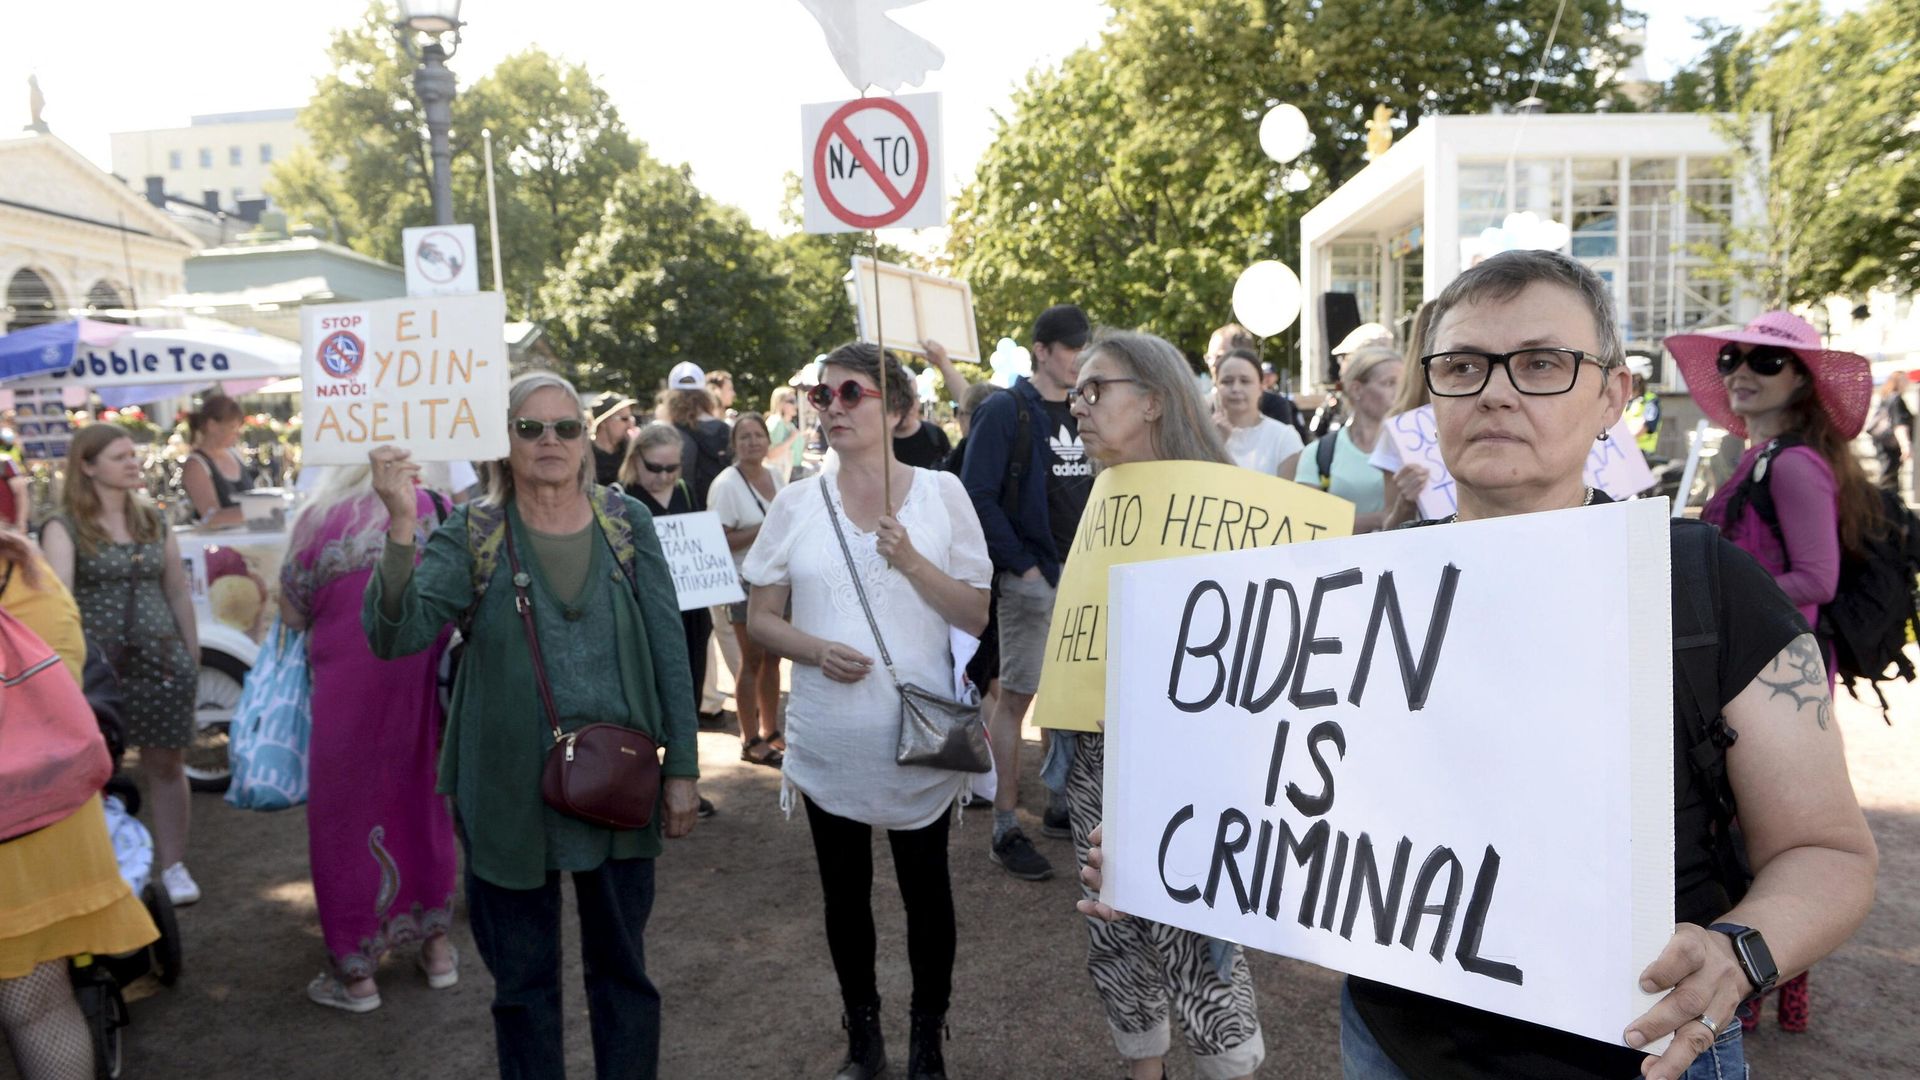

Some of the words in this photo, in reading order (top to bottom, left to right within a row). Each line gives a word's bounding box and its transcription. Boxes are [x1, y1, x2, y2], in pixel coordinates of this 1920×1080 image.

[829, 136, 910, 179] NATO
[321, 315, 363, 329] STOP
[396, 309, 437, 342] EI
[52, 349, 159, 379] ubble
[168, 347, 230, 372] Tea
[374, 349, 488, 388] YDIN-
[316, 383, 366, 398] NATO!
[314, 398, 481, 443] ASEITA
[1077, 494, 1143, 554] NATO
[1056, 604, 1109, 663] HEL
[1168, 562, 1462, 714] BIDEN
[1264, 719, 1346, 818] IS
[1158, 803, 1524, 986] CRIMINAL
